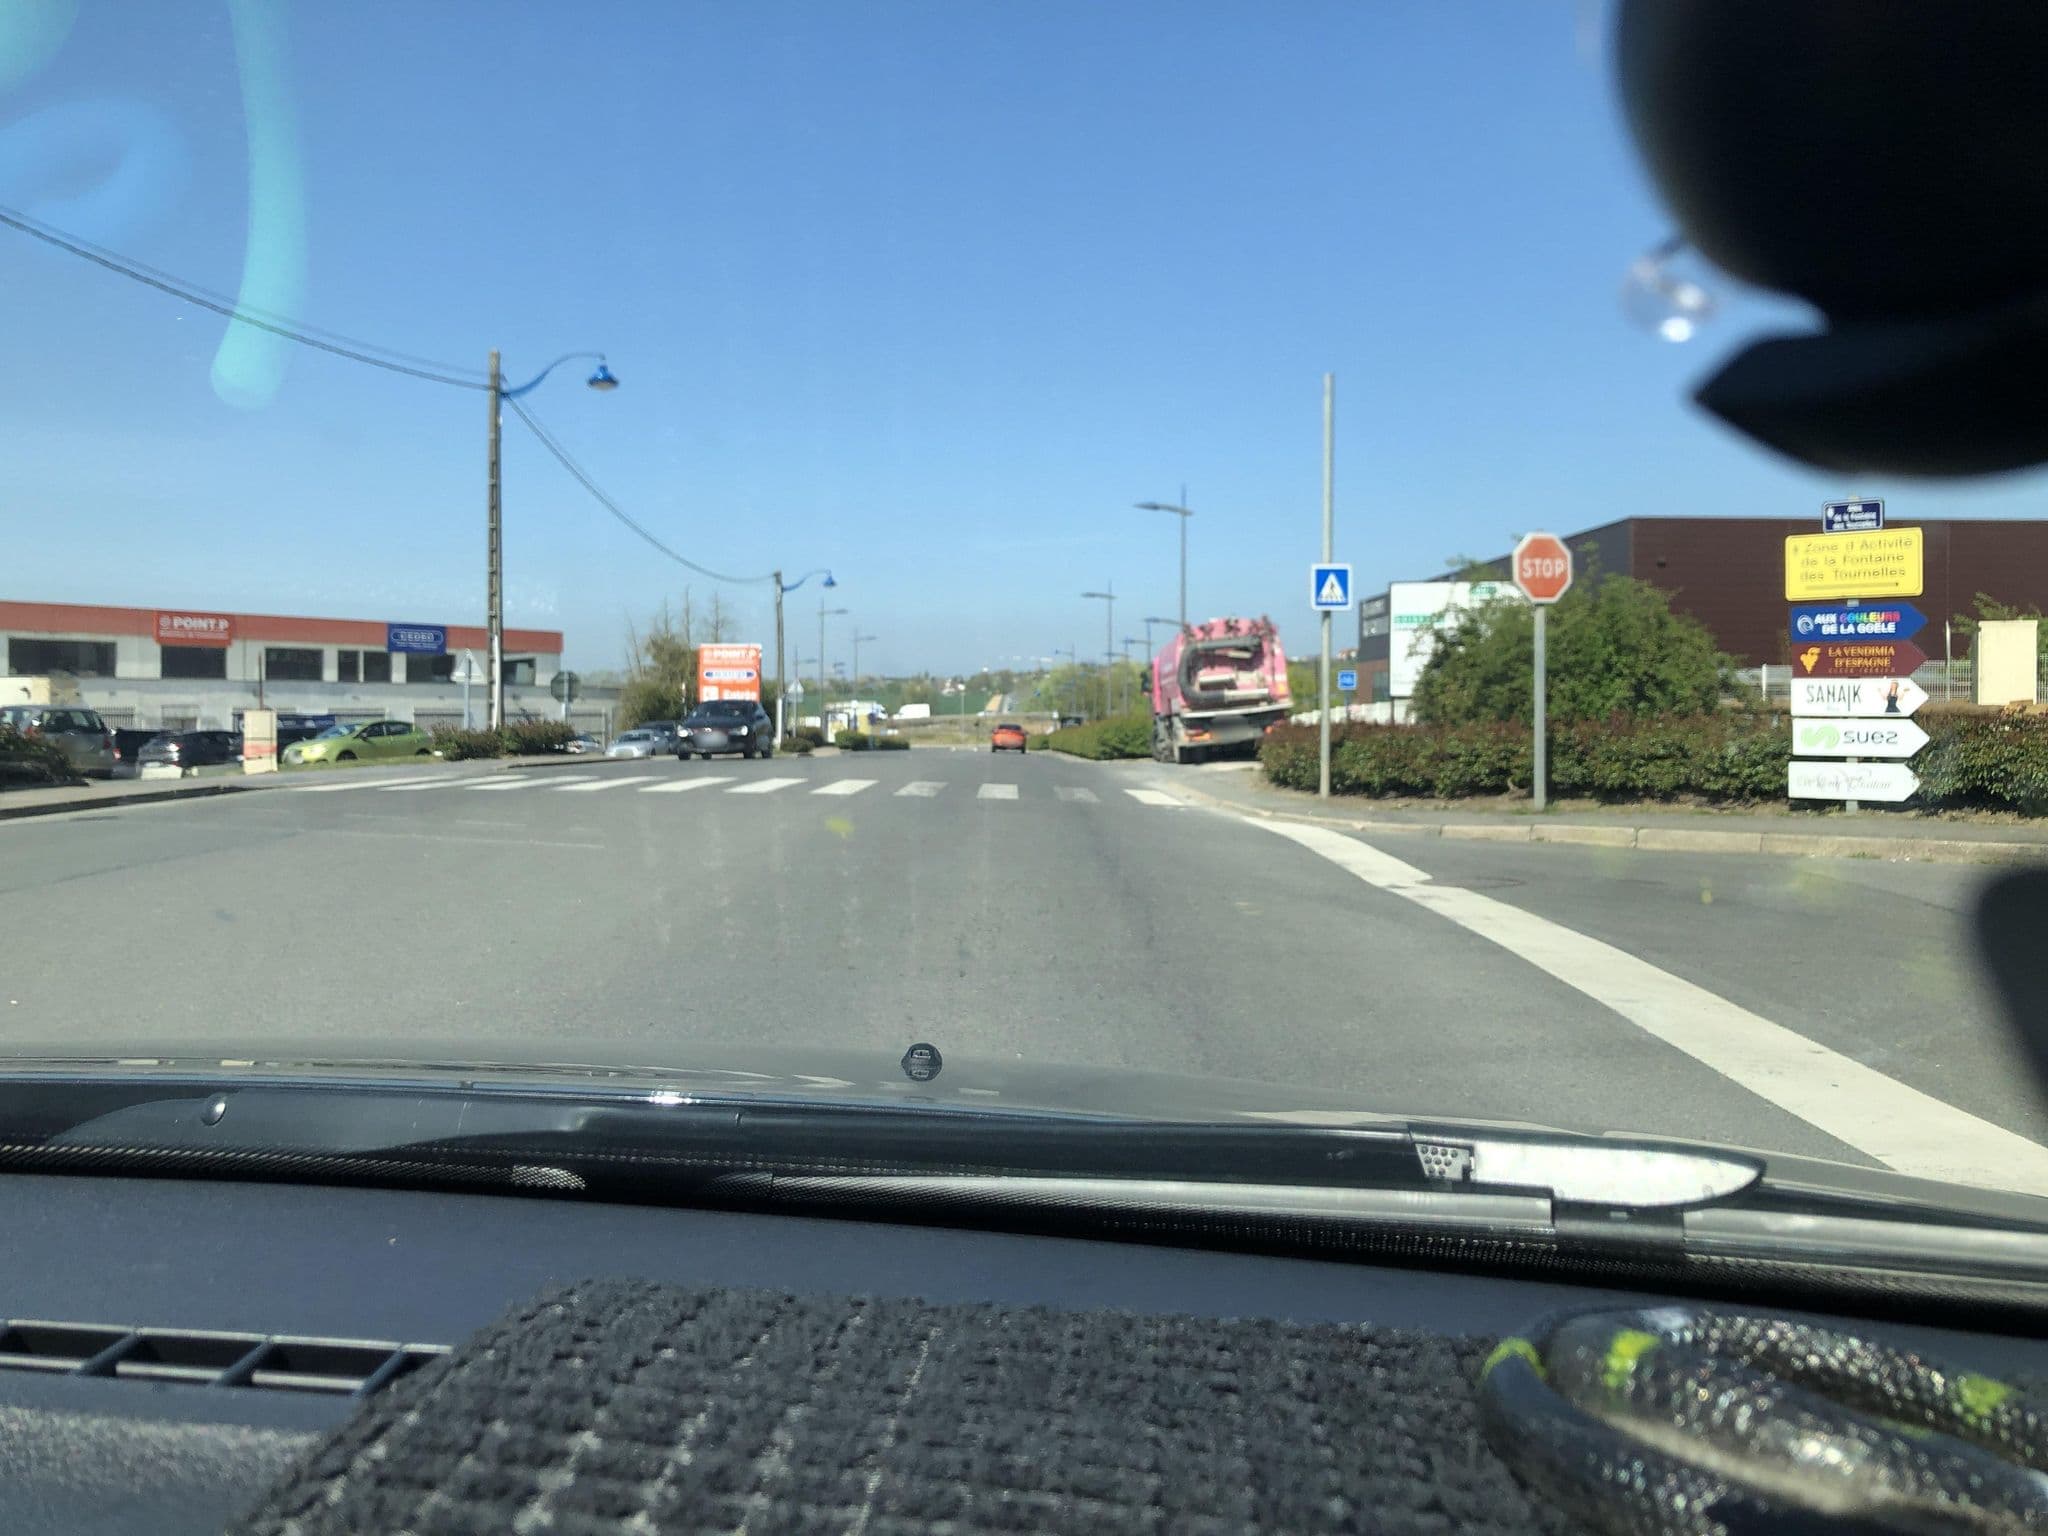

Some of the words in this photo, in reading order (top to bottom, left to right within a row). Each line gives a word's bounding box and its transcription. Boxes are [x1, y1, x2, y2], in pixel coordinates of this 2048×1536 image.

[1805, 542, 1838, 554] Zone
[1845, 536, 1913, 552] dActivité
[1801, 557, 1817, 567] de
[1824, 555, 1836, 566] la
[1843, 552, 1905, 566] Fontaine
[1522, 557, 1566, 579] STOP
[1800, 569, 1824, 582] des
[1833, 566, 1907, 581] Tournelles
[1814, 612, 1837, 625] AUX
[1839, 611, 1901, 624] COULEURS
[1822, 624, 1838, 635] DE
[1840, 623, 1855, 635] LA
[1828, 646, 1842, 657] LA
[1843, 645, 1895, 657] VENDIMIA
[1834, 657, 1891, 668] D'ESPAGNE
[1843, 730, 1899, 745] suez
